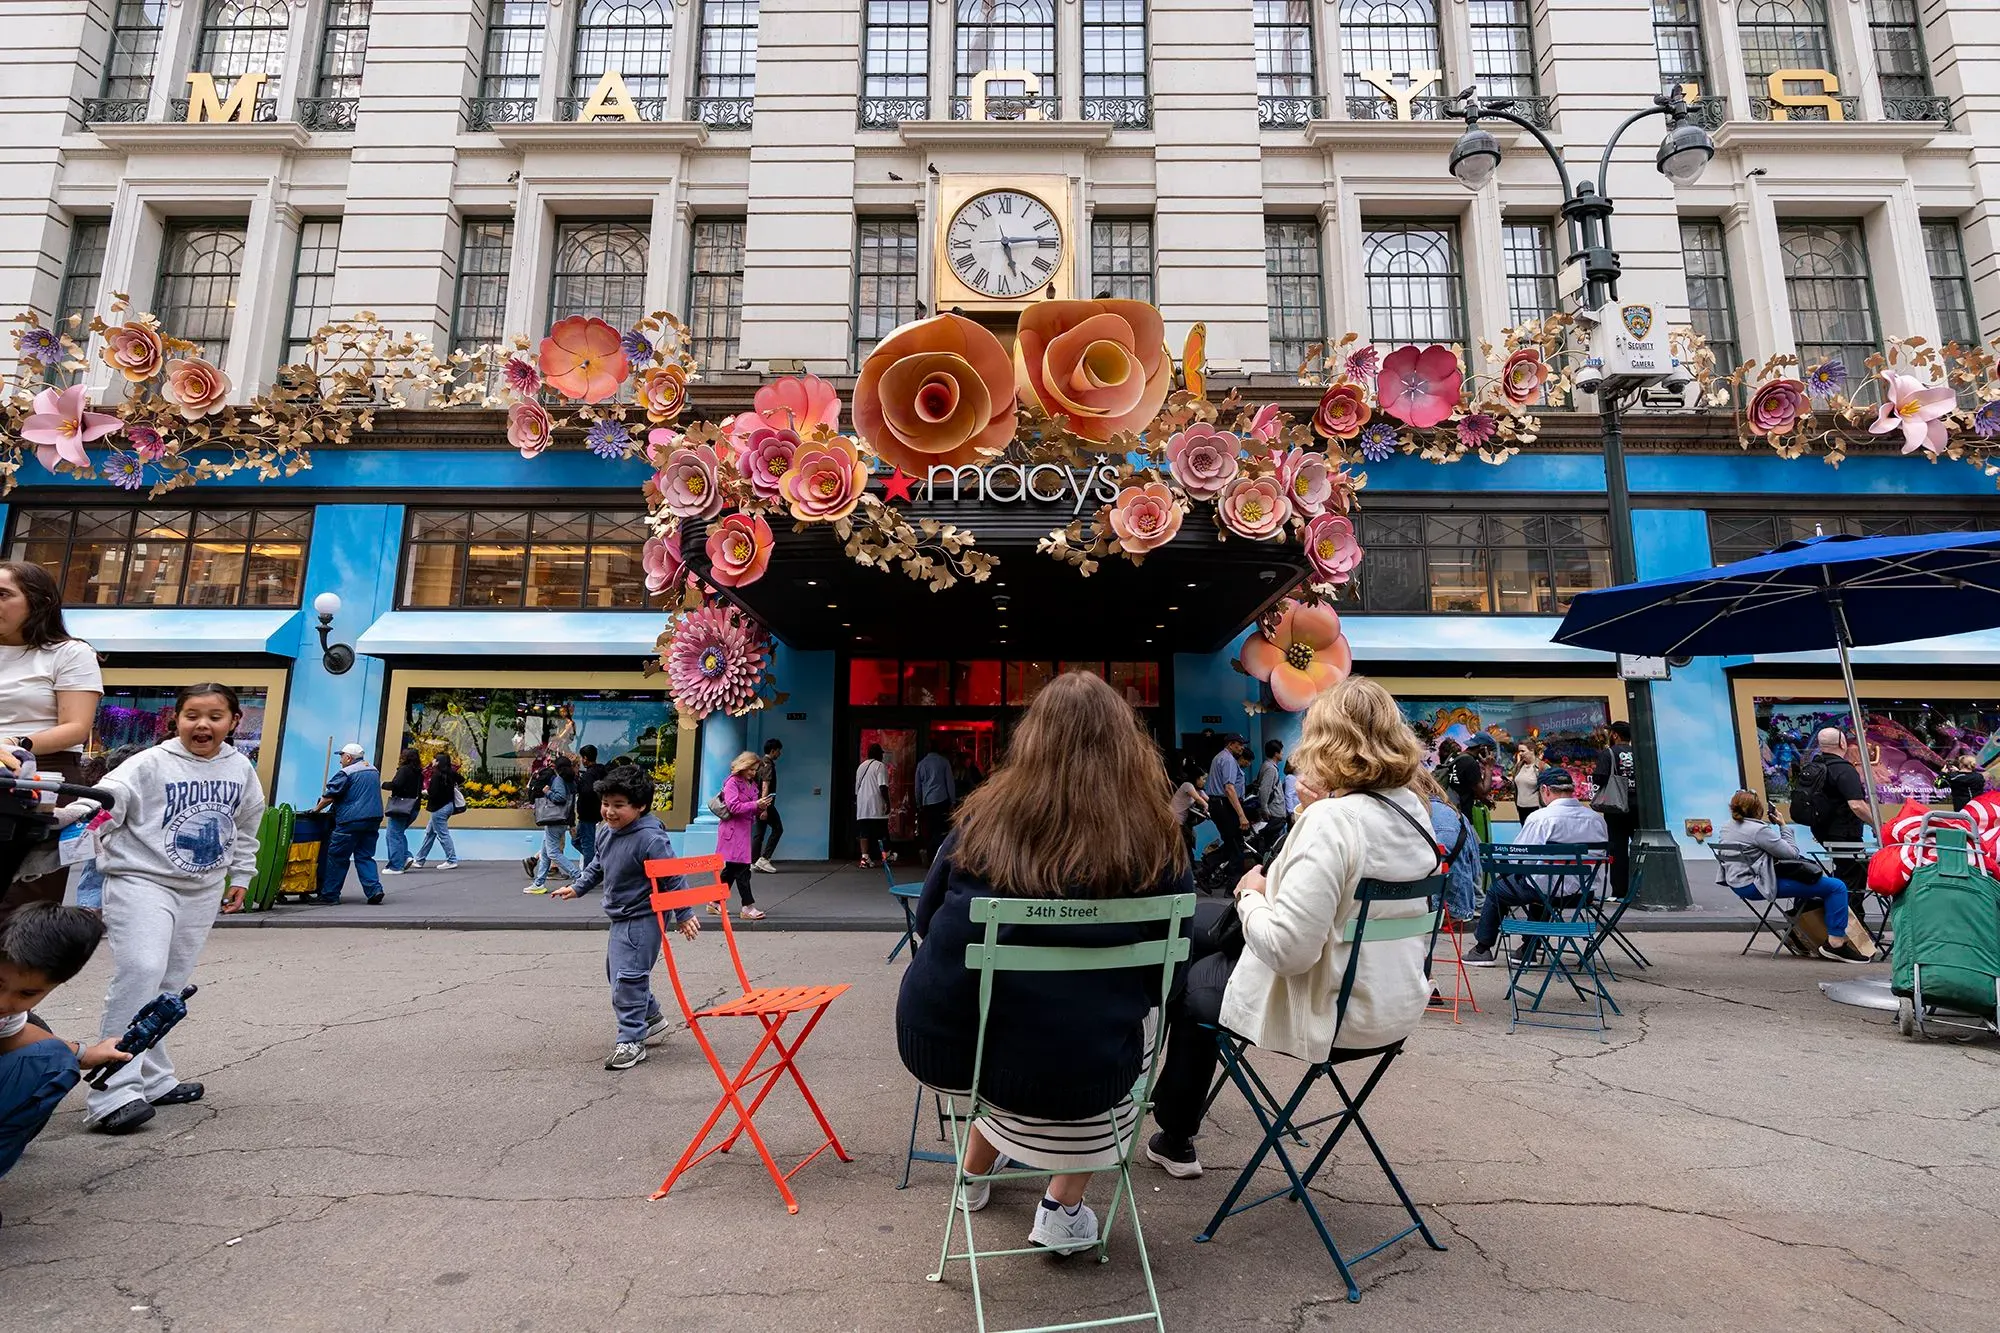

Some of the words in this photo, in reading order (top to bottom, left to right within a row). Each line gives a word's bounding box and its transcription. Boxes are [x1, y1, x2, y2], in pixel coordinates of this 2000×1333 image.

[1627, 341, 1655, 351] SECURITY
[1631, 359, 1655, 369] CAMERA
[927, 455, 1120, 516] macy's
[1026, 906, 1056, 918] 34th
[1059, 906, 1098, 918] Street
